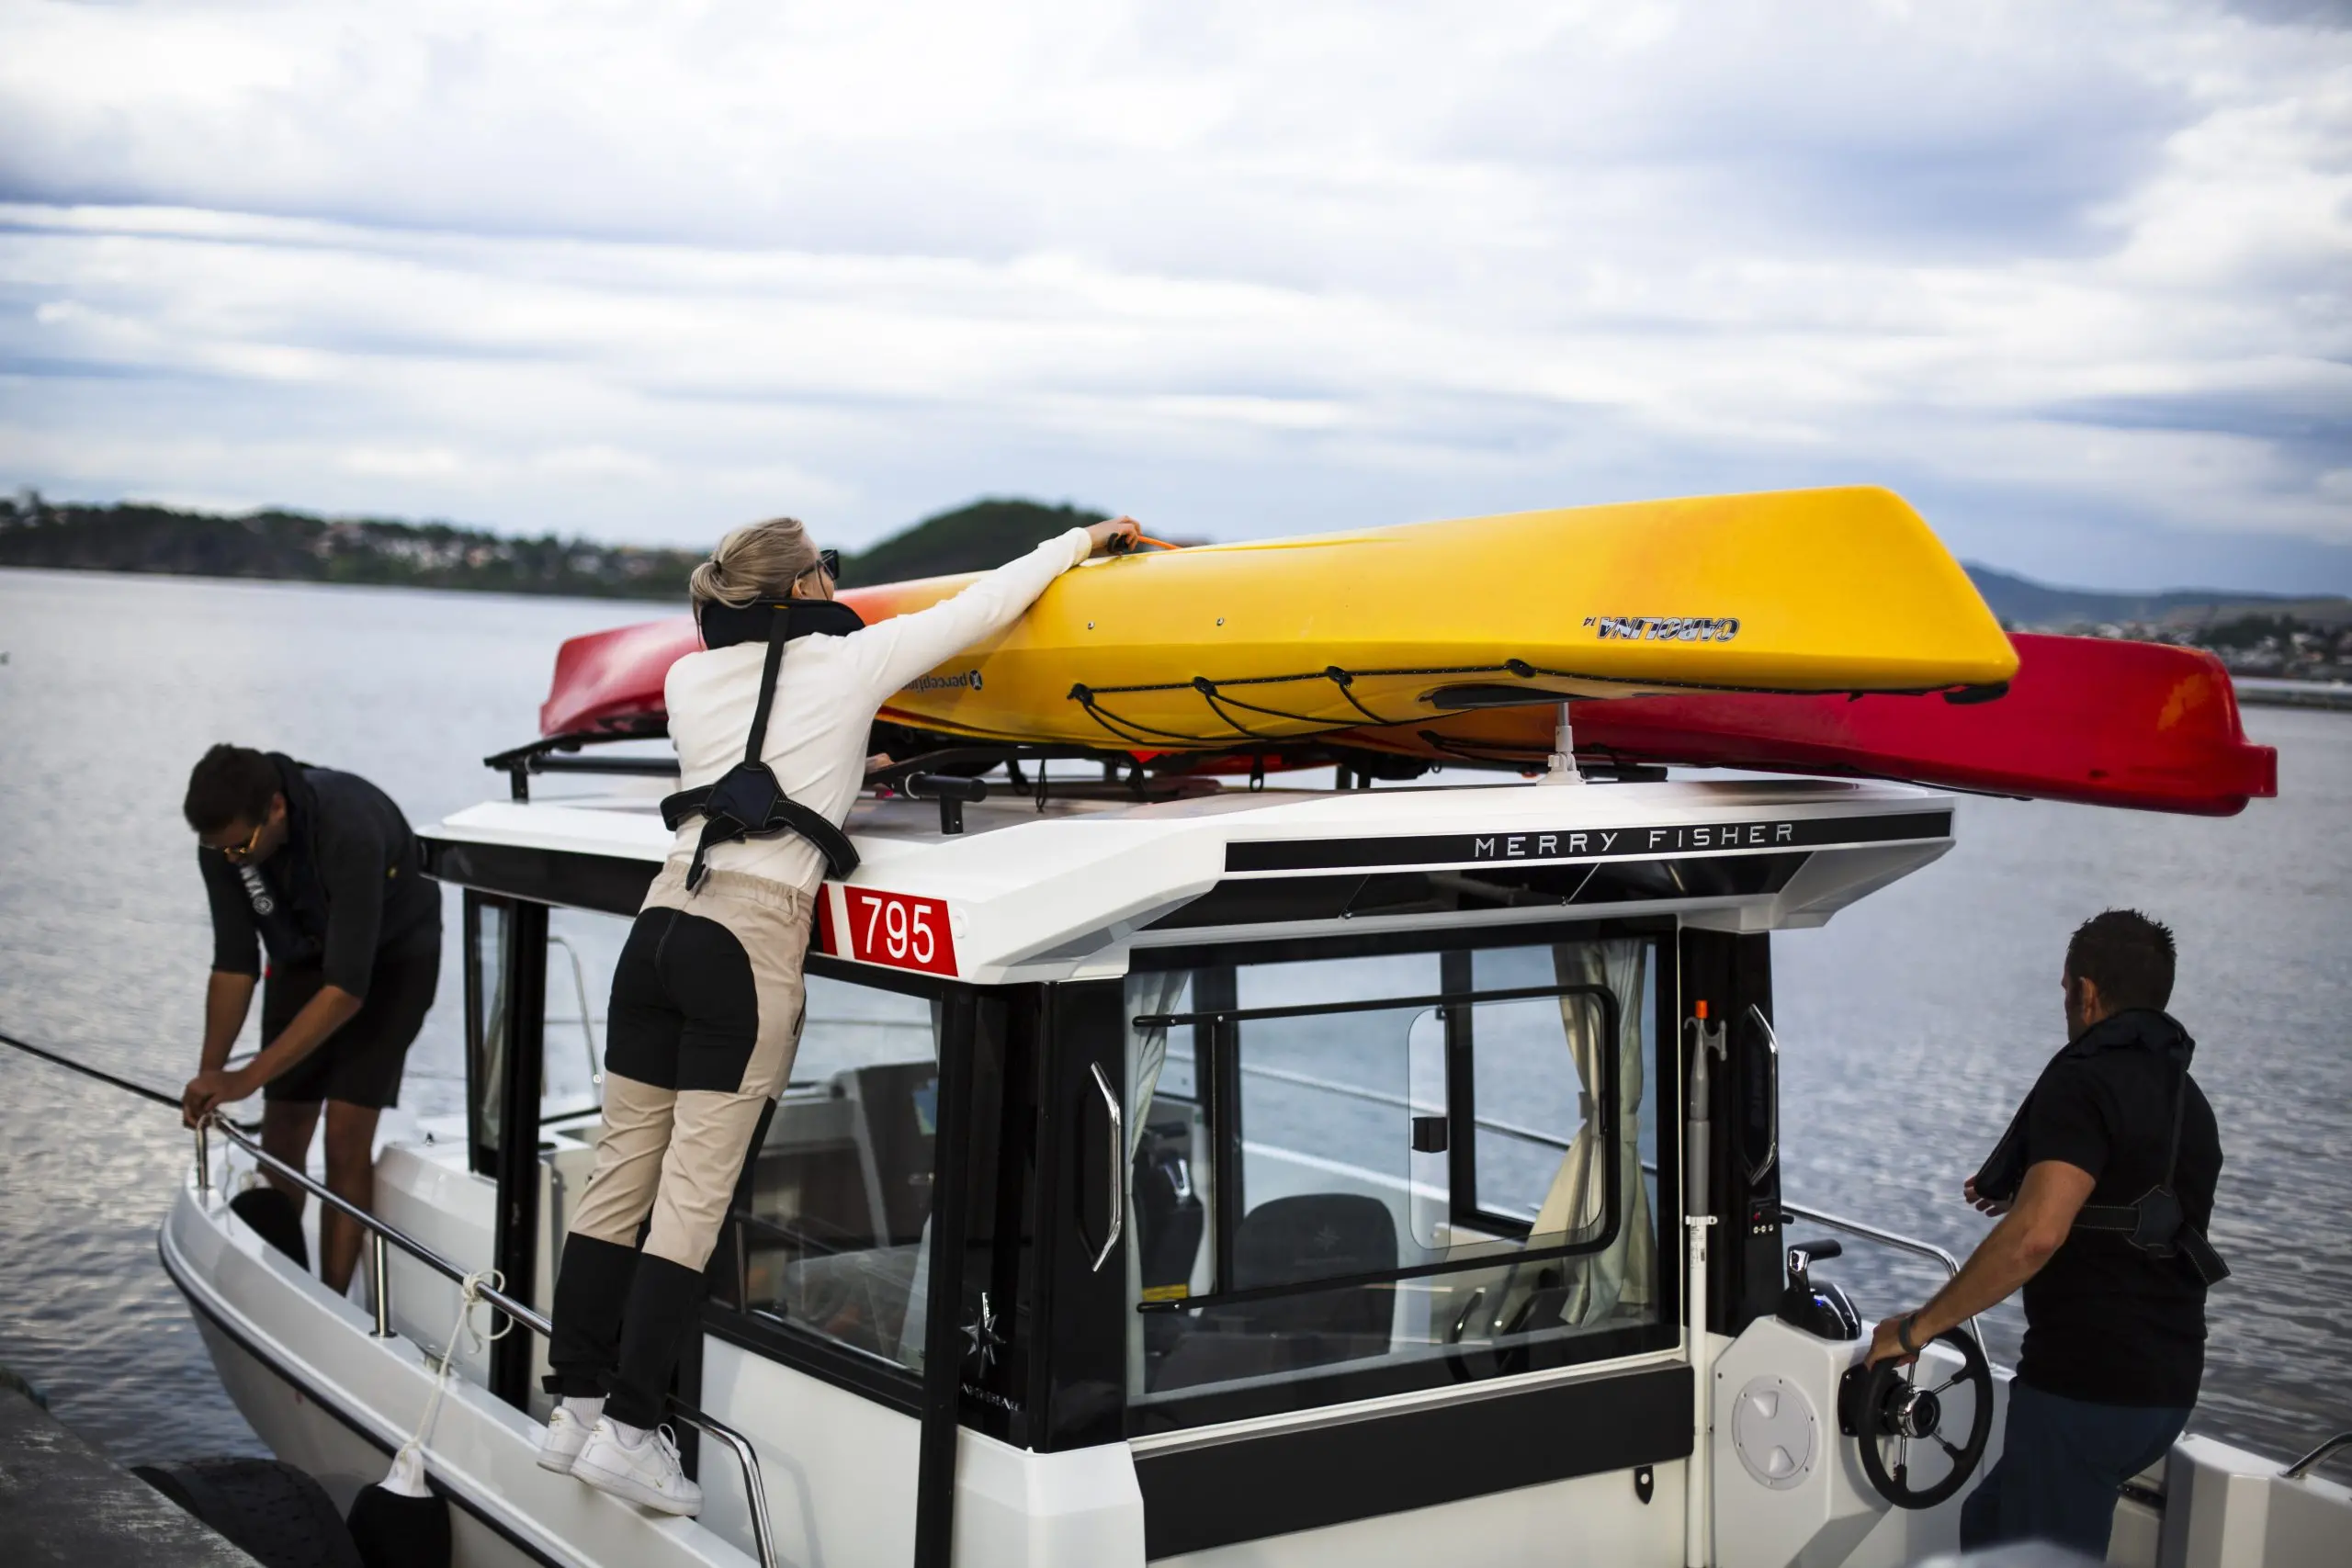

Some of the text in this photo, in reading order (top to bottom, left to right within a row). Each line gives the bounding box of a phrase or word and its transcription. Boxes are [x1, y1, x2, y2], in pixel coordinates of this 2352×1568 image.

[1583, 616, 1740, 642] CAROLINA 14
[1474, 824, 1792, 858] MERRY FISHER
[861, 896, 934, 964] 795
